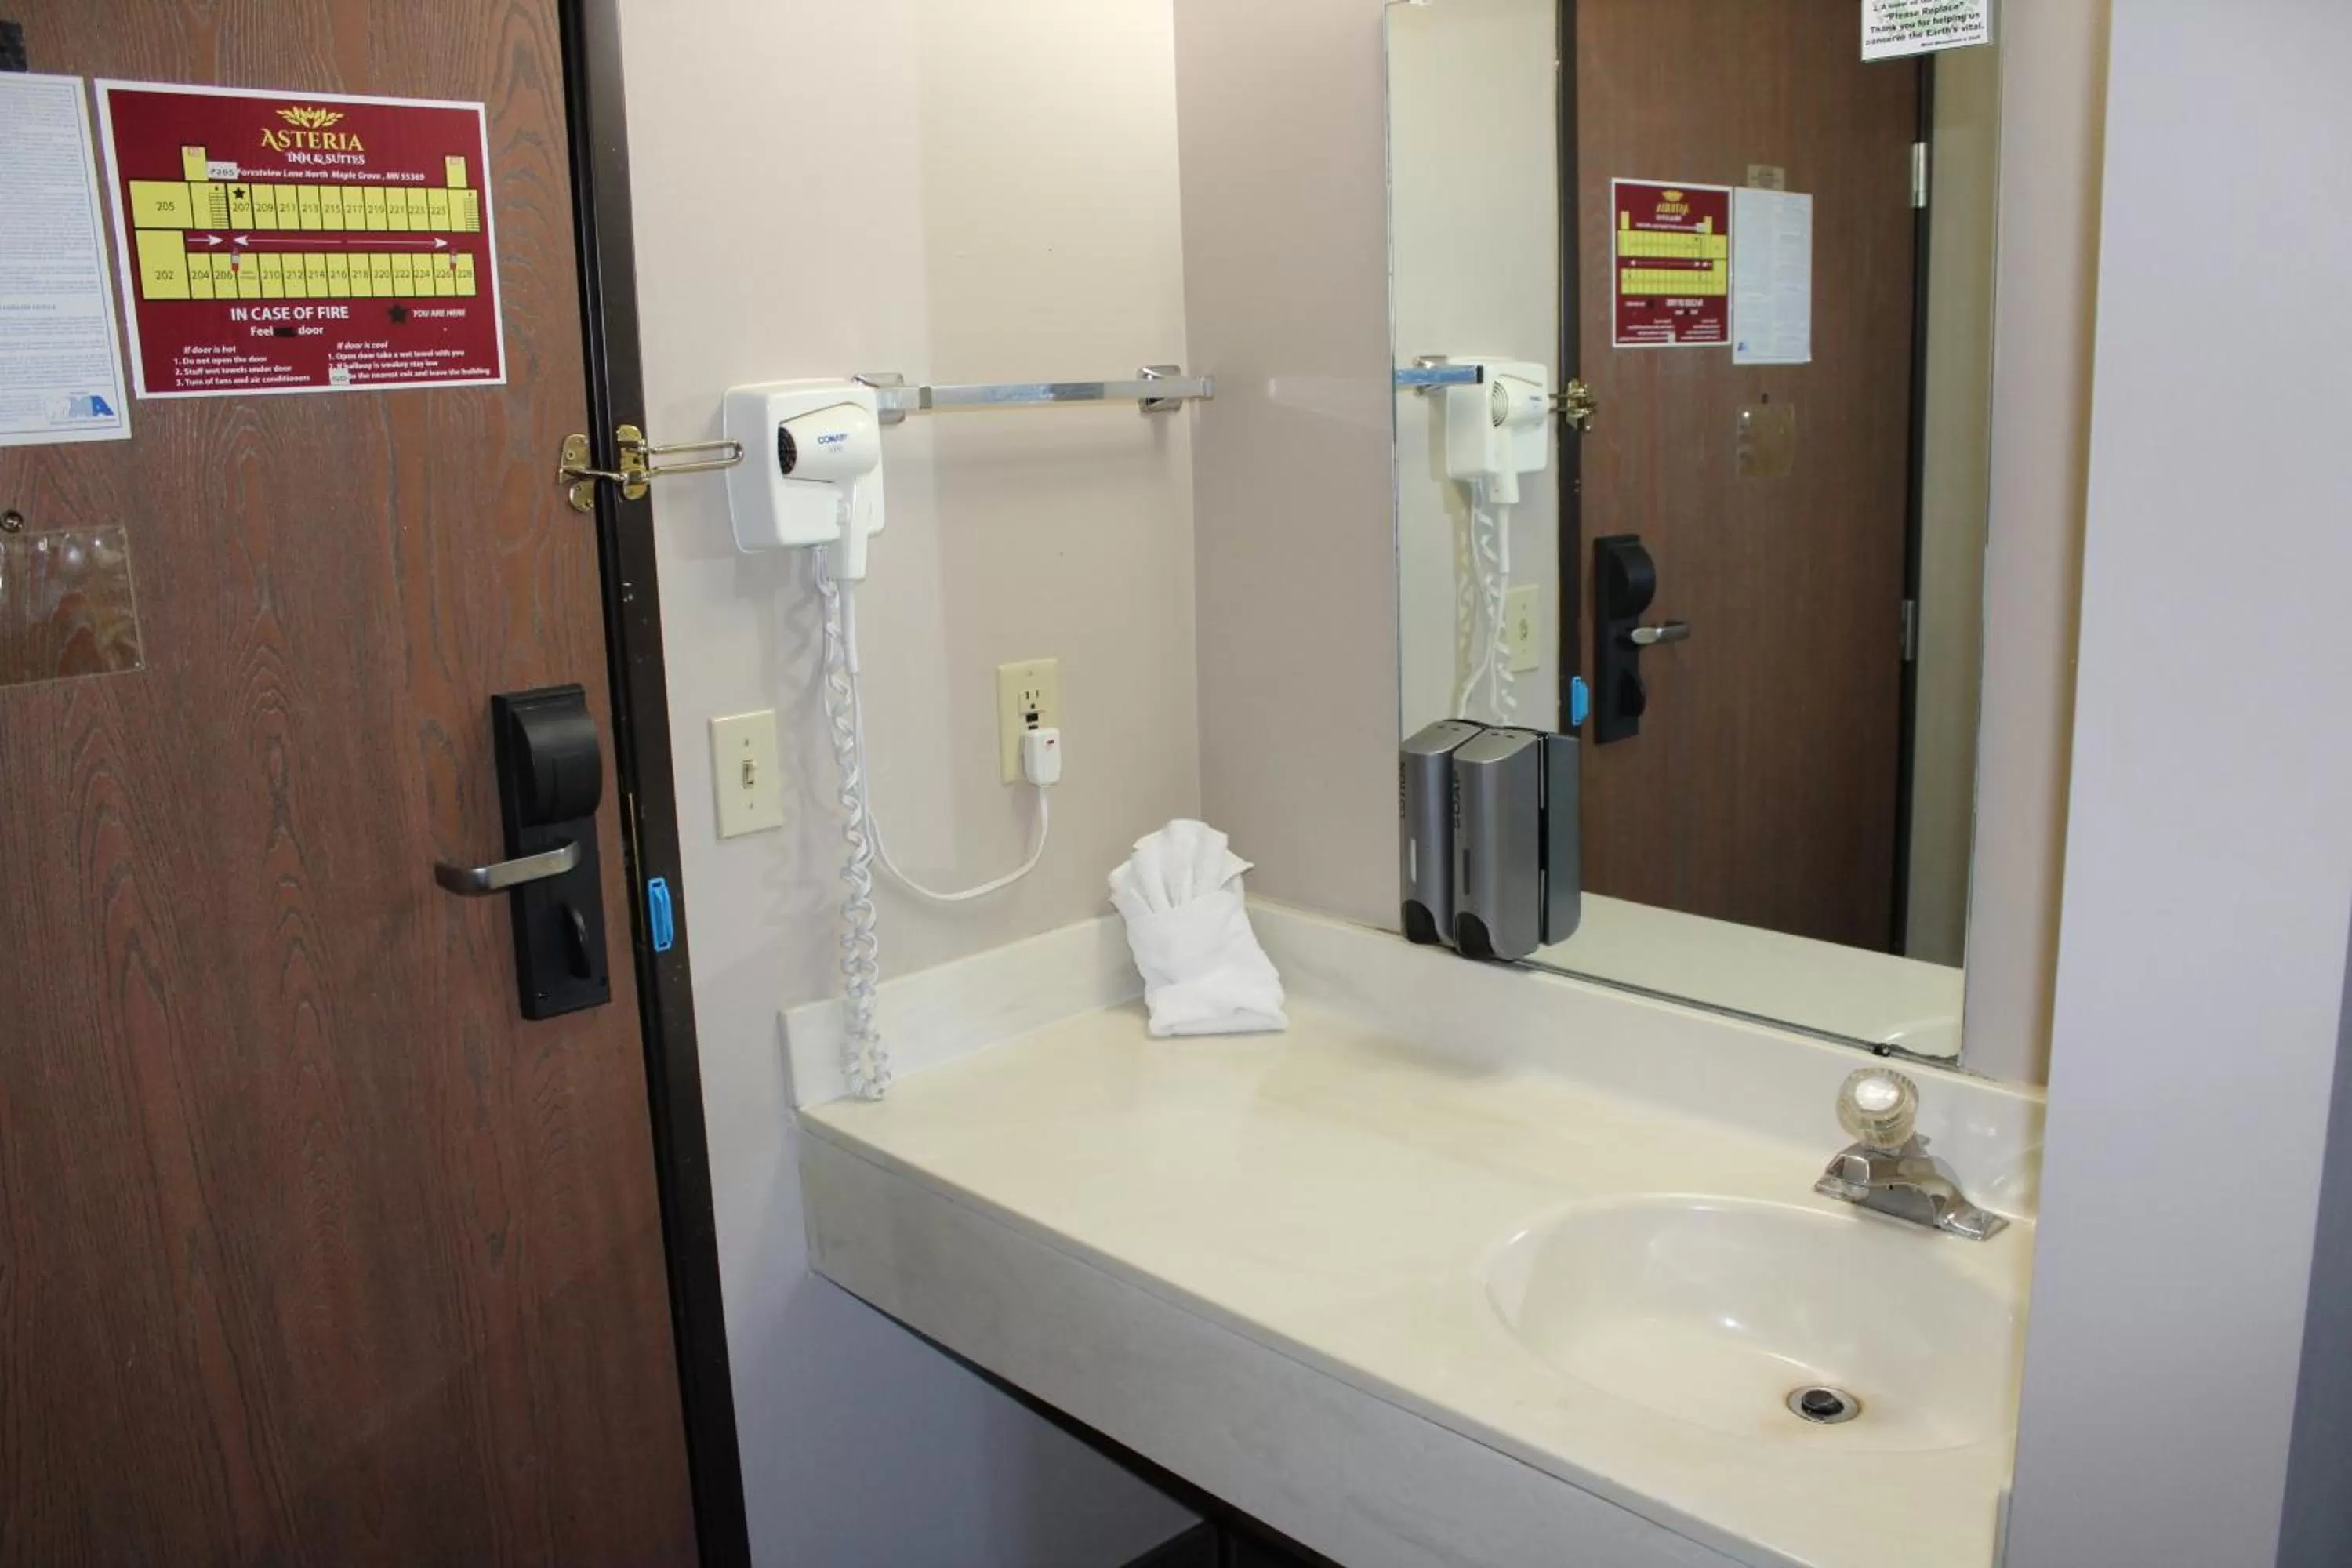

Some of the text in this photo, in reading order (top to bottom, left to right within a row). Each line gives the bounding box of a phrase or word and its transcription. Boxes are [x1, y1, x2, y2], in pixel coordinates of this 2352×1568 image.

[1871, 24, 1896, 34] Thank
[1900, 22, 1915, 31] you
[1933, 14, 1966, 24] helping
[1926, 25, 1958, 37] Earth's
[260, 128, 364, 151] ASTERIA
[286, 152, 313, 164] INN
[325, 153, 366, 165] SUITES
[237, 167, 282, 176] Forestview
[283, 169, 303, 178] Lane
[332, 170, 356, 180] Maple
[386, 172, 400, 180] MN
[156, 201, 175, 211] 205
[233, 202, 249, 212] 207
[256, 203, 273, 212] 209
[281, 203, 296, 212] 211
[302, 204, 319, 213] 213
[324, 204, 341, 213] 215
[347, 204, 363, 213] 217
[368, 204, 385, 213] 219
[390, 205, 405, 214] 221
[154, 270, 174, 280] 202
[191, 270, 209, 280] 204
[215, 270, 233, 280] 206
[263, 270, 281, 280] 210
[286, 270, 303, 280] 212
[308, 270, 325, 279] 214
[330, 270, 347, 279] 216
[353, 269, 369, 278] 218
[374, 269, 390, 278] 220
[395, 269, 410, 278] 222
[414, 269, 430, 278] 224
[230, 306, 349, 321] IN CASE OF FIRE
[250, 325, 323, 336] Feel door
[183, 367, 203, 376] Stuff
